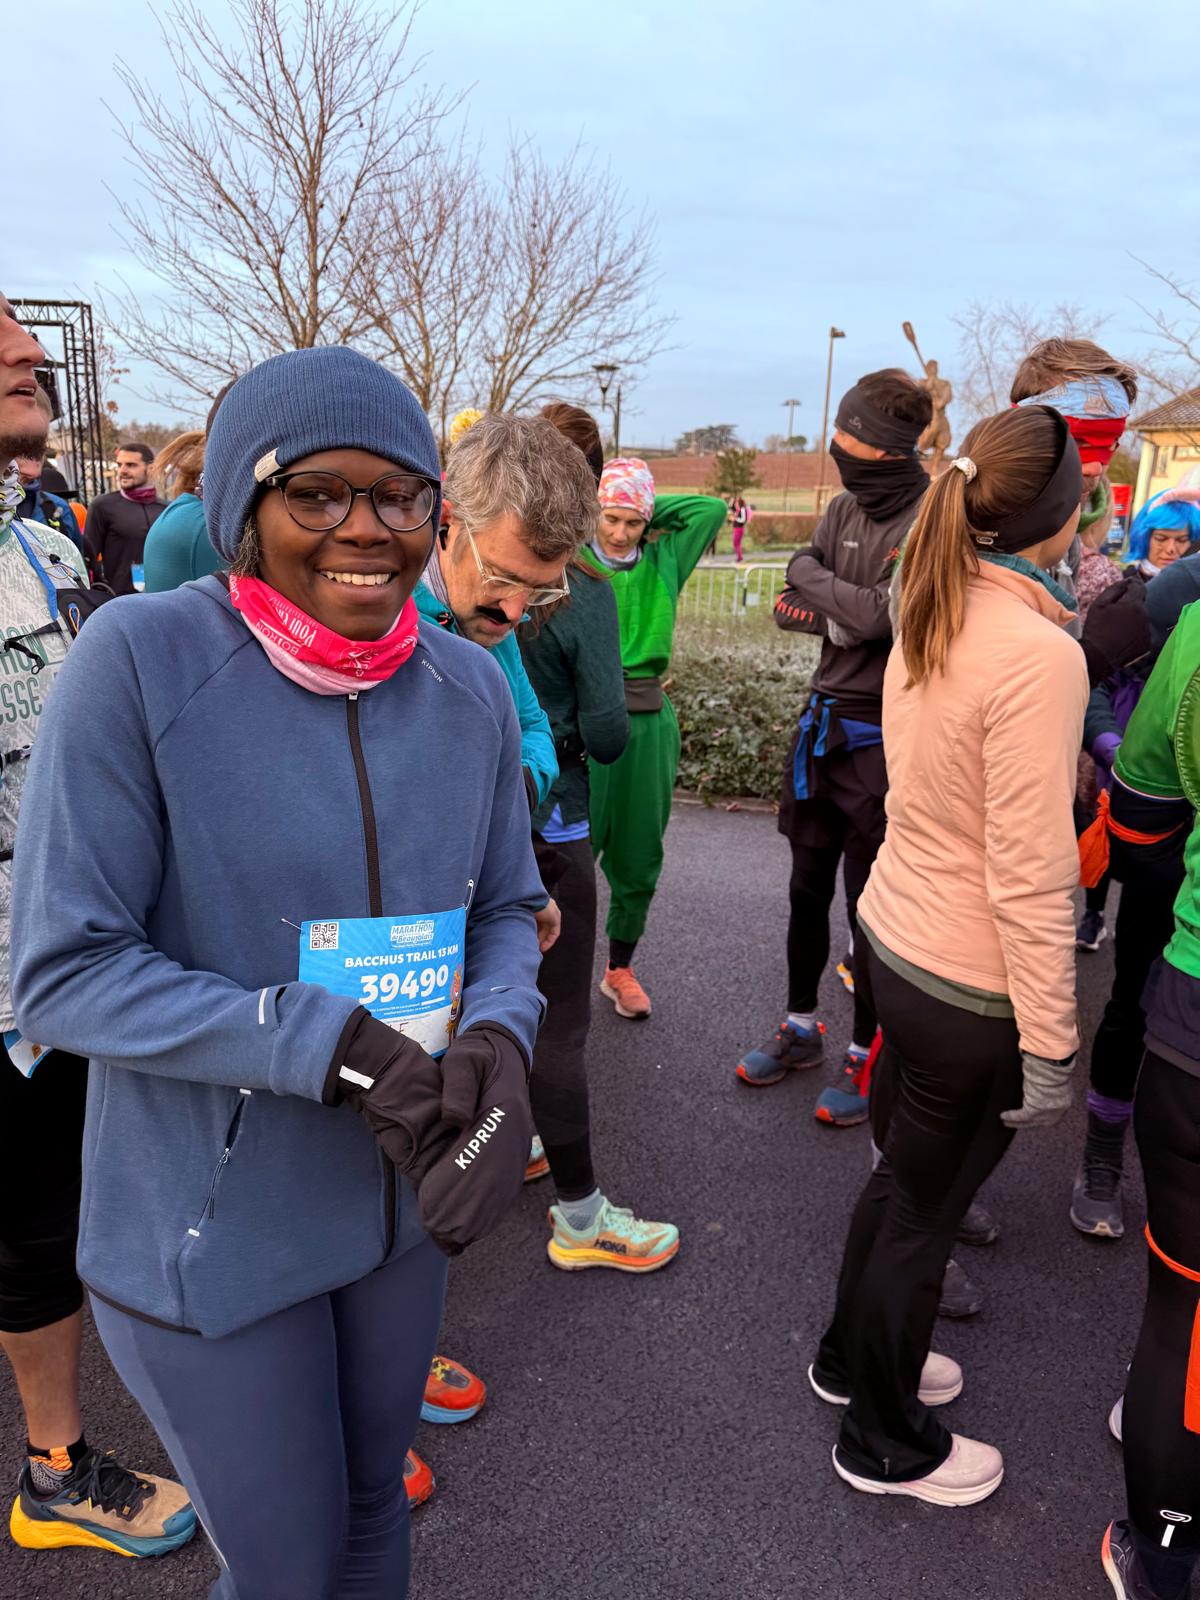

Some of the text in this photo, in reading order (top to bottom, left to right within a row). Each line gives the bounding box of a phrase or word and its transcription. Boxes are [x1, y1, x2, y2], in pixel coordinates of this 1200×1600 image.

[256, 621, 299, 656] BOIRON
[421, 659, 443, 683] KIPRUN
[0, 677, 43, 723] SSE
[392, 923, 434, 935] MARATHON
[344, 953, 405, 968] BACCHUS
[406, 949, 437, 963] TRAIL
[447, 943, 459, 956] KM
[359, 963, 449, 1005] 39490
[454, 1106, 506, 1170] KIPRUN
[593, 1238, 627, 1255] HOKA
